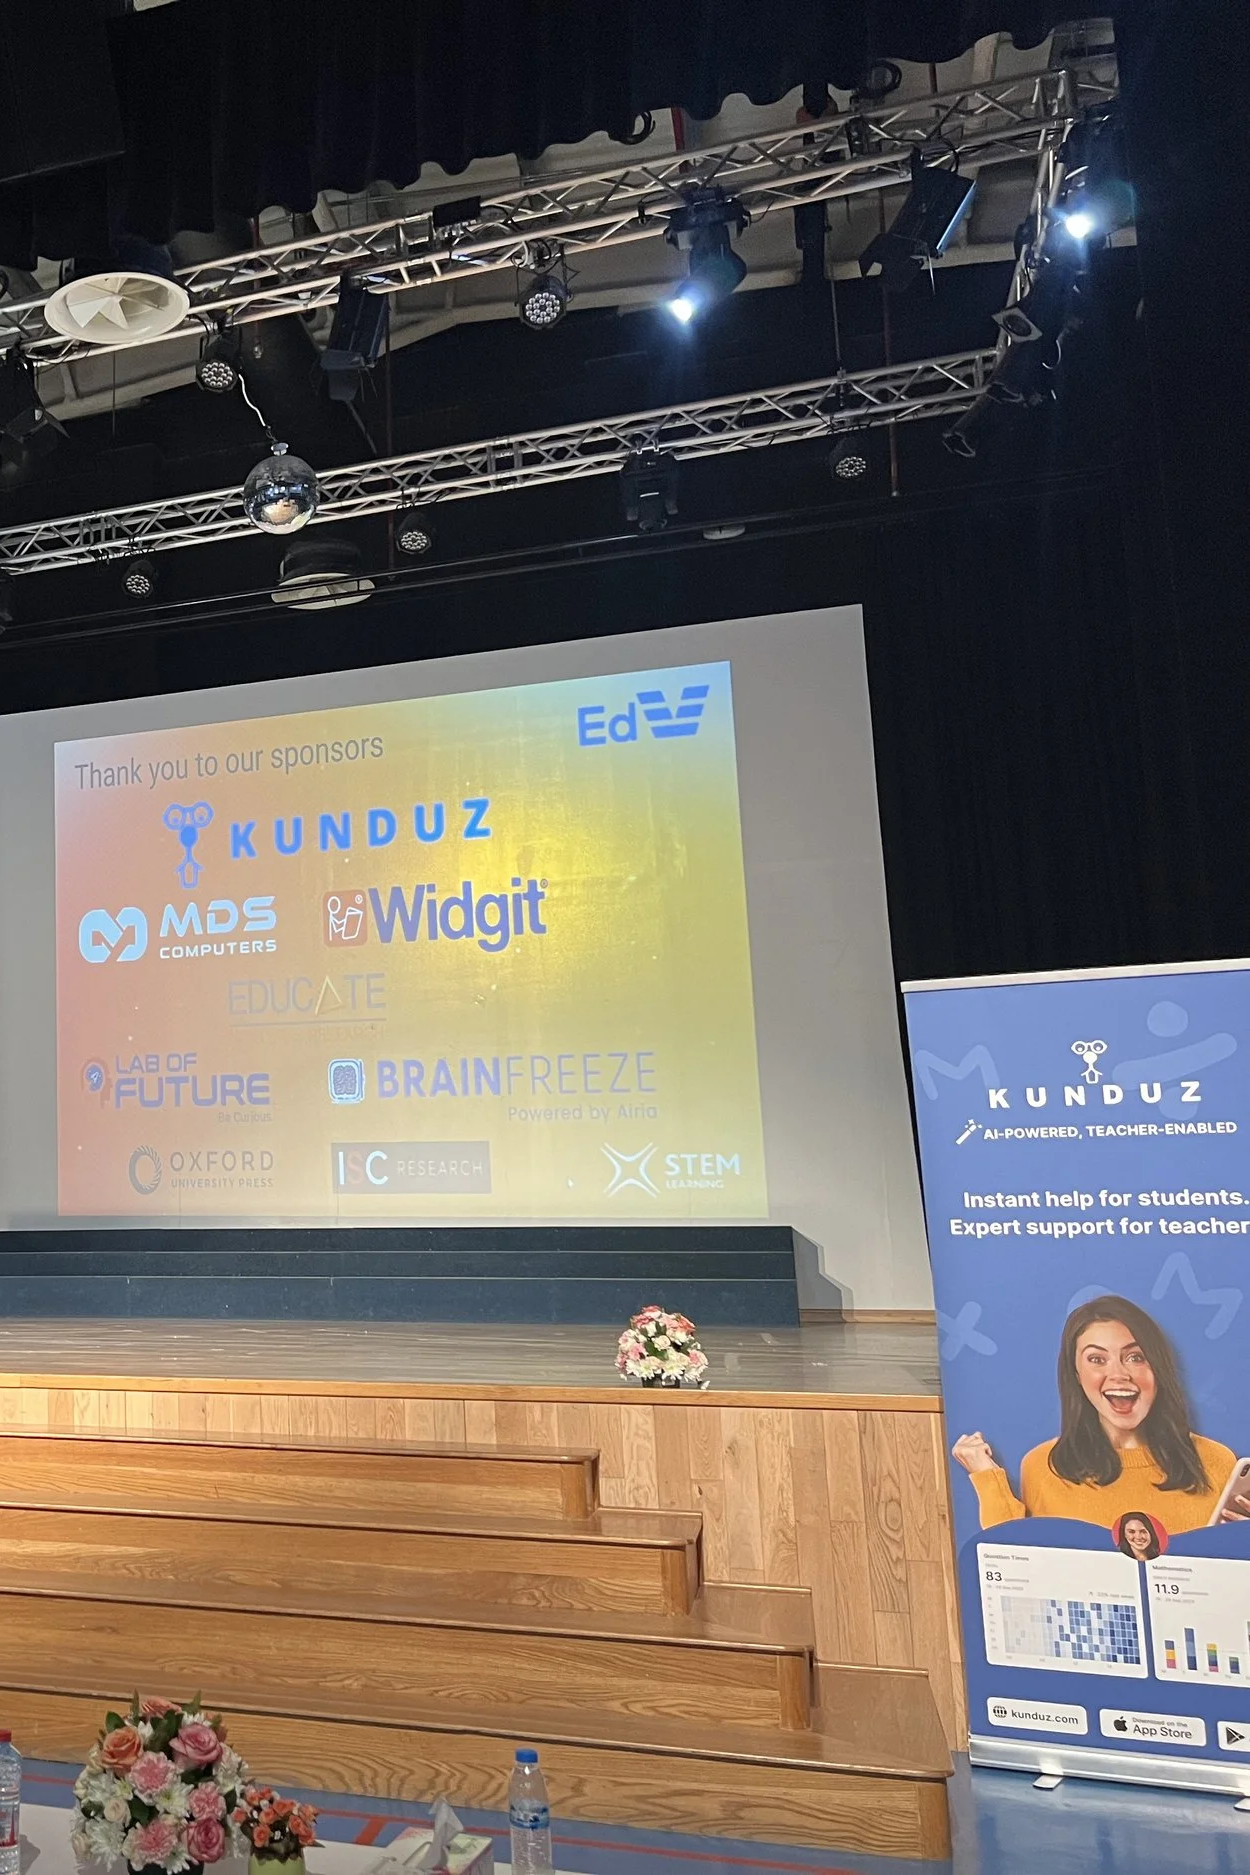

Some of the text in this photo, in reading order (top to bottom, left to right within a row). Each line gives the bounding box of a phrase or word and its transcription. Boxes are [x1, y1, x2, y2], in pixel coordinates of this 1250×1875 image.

[75, 736, 384, 790] Thank you to our sponsors
[229, 797, 493, 860] KUNDUZ
[159, 895, 277, 938] MDS
[367, 876, 548, 953] Widgit
[159, 939, 278, 959] COMPUTERS
[228, 972, 387, 1017] EDUCATE
[115, 1052, 197, 1074] LAB OF
[376, 1051, 658, 1099] BRAINFREEZE
[114, 1073, 270, 1109] FUTURE
[988, 1081, 1202, 1109] KUNDUZ
[217, 1111, 231, 1123] Be
[508, 1102, 658, 1124] Powered by Airia
[983, 1121, 1238, 1140] AI-POWERED, TEACHER-ENABLED
[170, 1150, 274, 1172] OXFORD
[338, 1150, 484, 1186] ISC RESEARCH
[664, 1153, 741, 1176] STEM
[171, 1178, 274, 1189] UNIVERSITY PRESS
[665, 1179, 724, 1189] LEARNING
[963, 1188, 1250, 1210] Instant help for students.
[950, 1219, 1021, 1239] Expert
[1026, 1219, 1115, 1239] support
[1119, 1217, 1154, 1234] for
[986, 1571, 1002, 1581] 83
[1154, 1583, 1179, 1595] 11.9
[1011, 1709, 1079, 1725] kunduz.com
[1133, 1724, 1193, 1739] App Store
